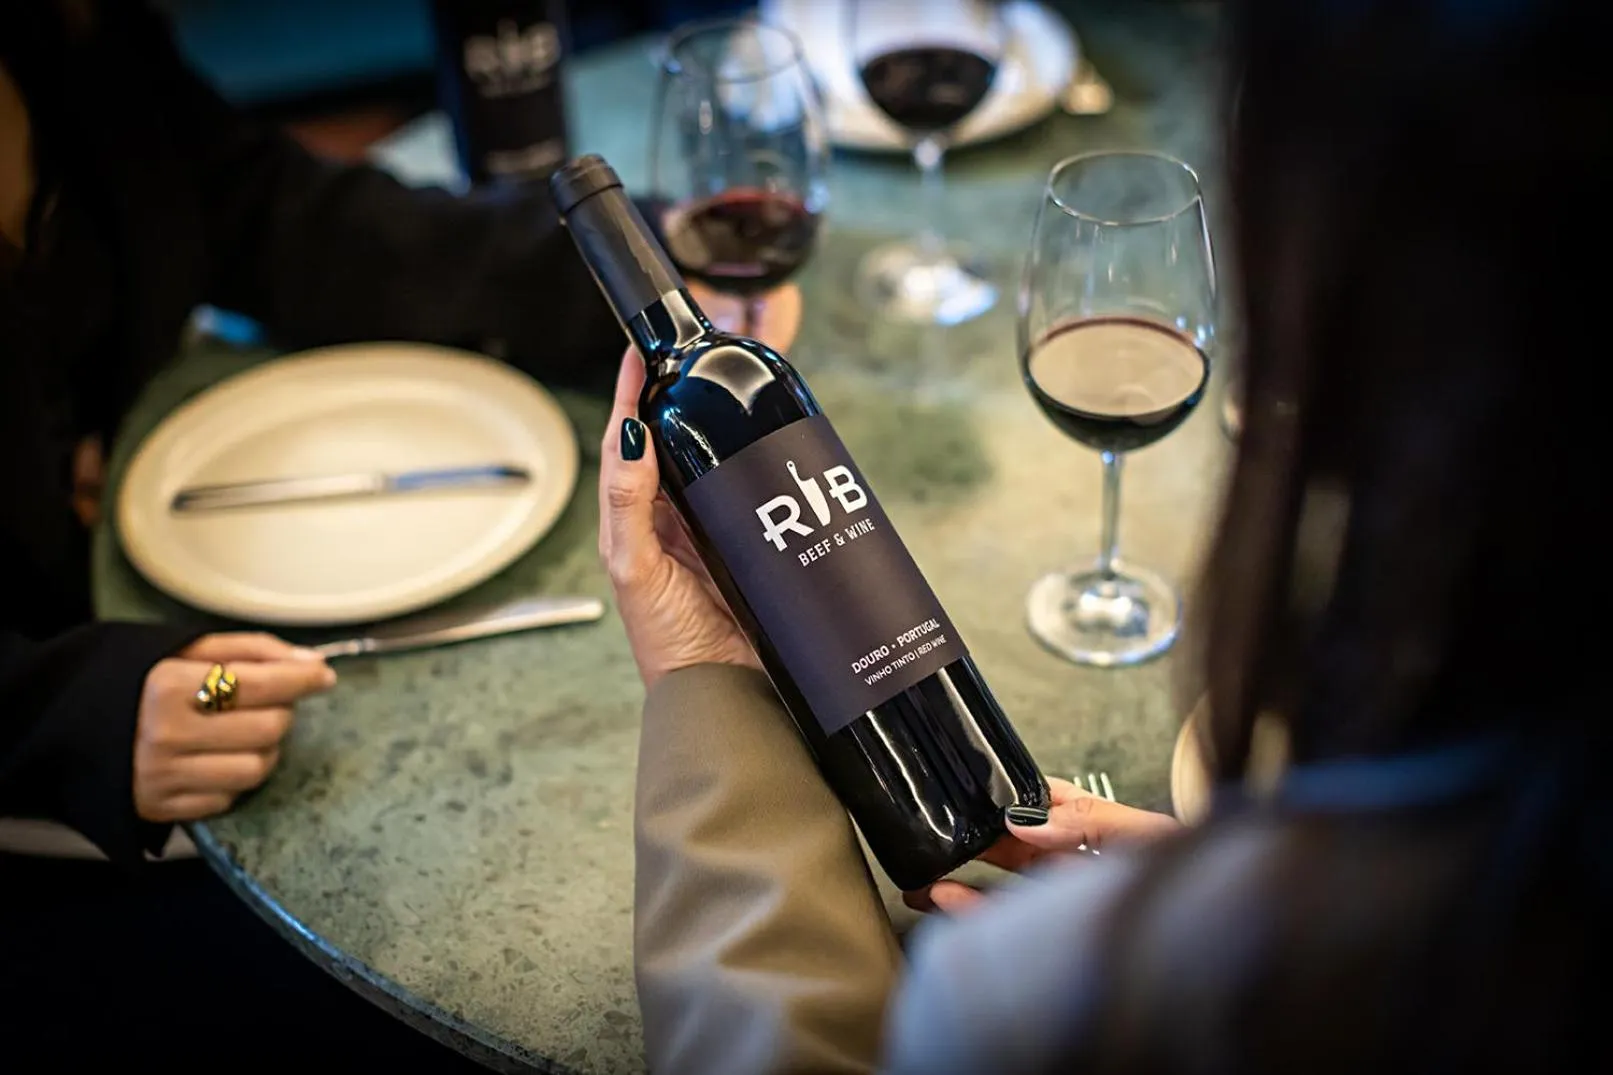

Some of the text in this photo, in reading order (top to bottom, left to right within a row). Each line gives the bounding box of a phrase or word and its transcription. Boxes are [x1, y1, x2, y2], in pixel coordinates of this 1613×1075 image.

[756, 460, 868, 552] RIB
[798, 518, 875, 567] BEEF & WINE
[851, 618, 940, 674] DOURO PORTUGAL
[864, 668, 892, 685] VINHO
[891, 653, 915, 670] TINTO
[917, 642, 932, 656] RED
[931, 634, 947, 648] WINE
